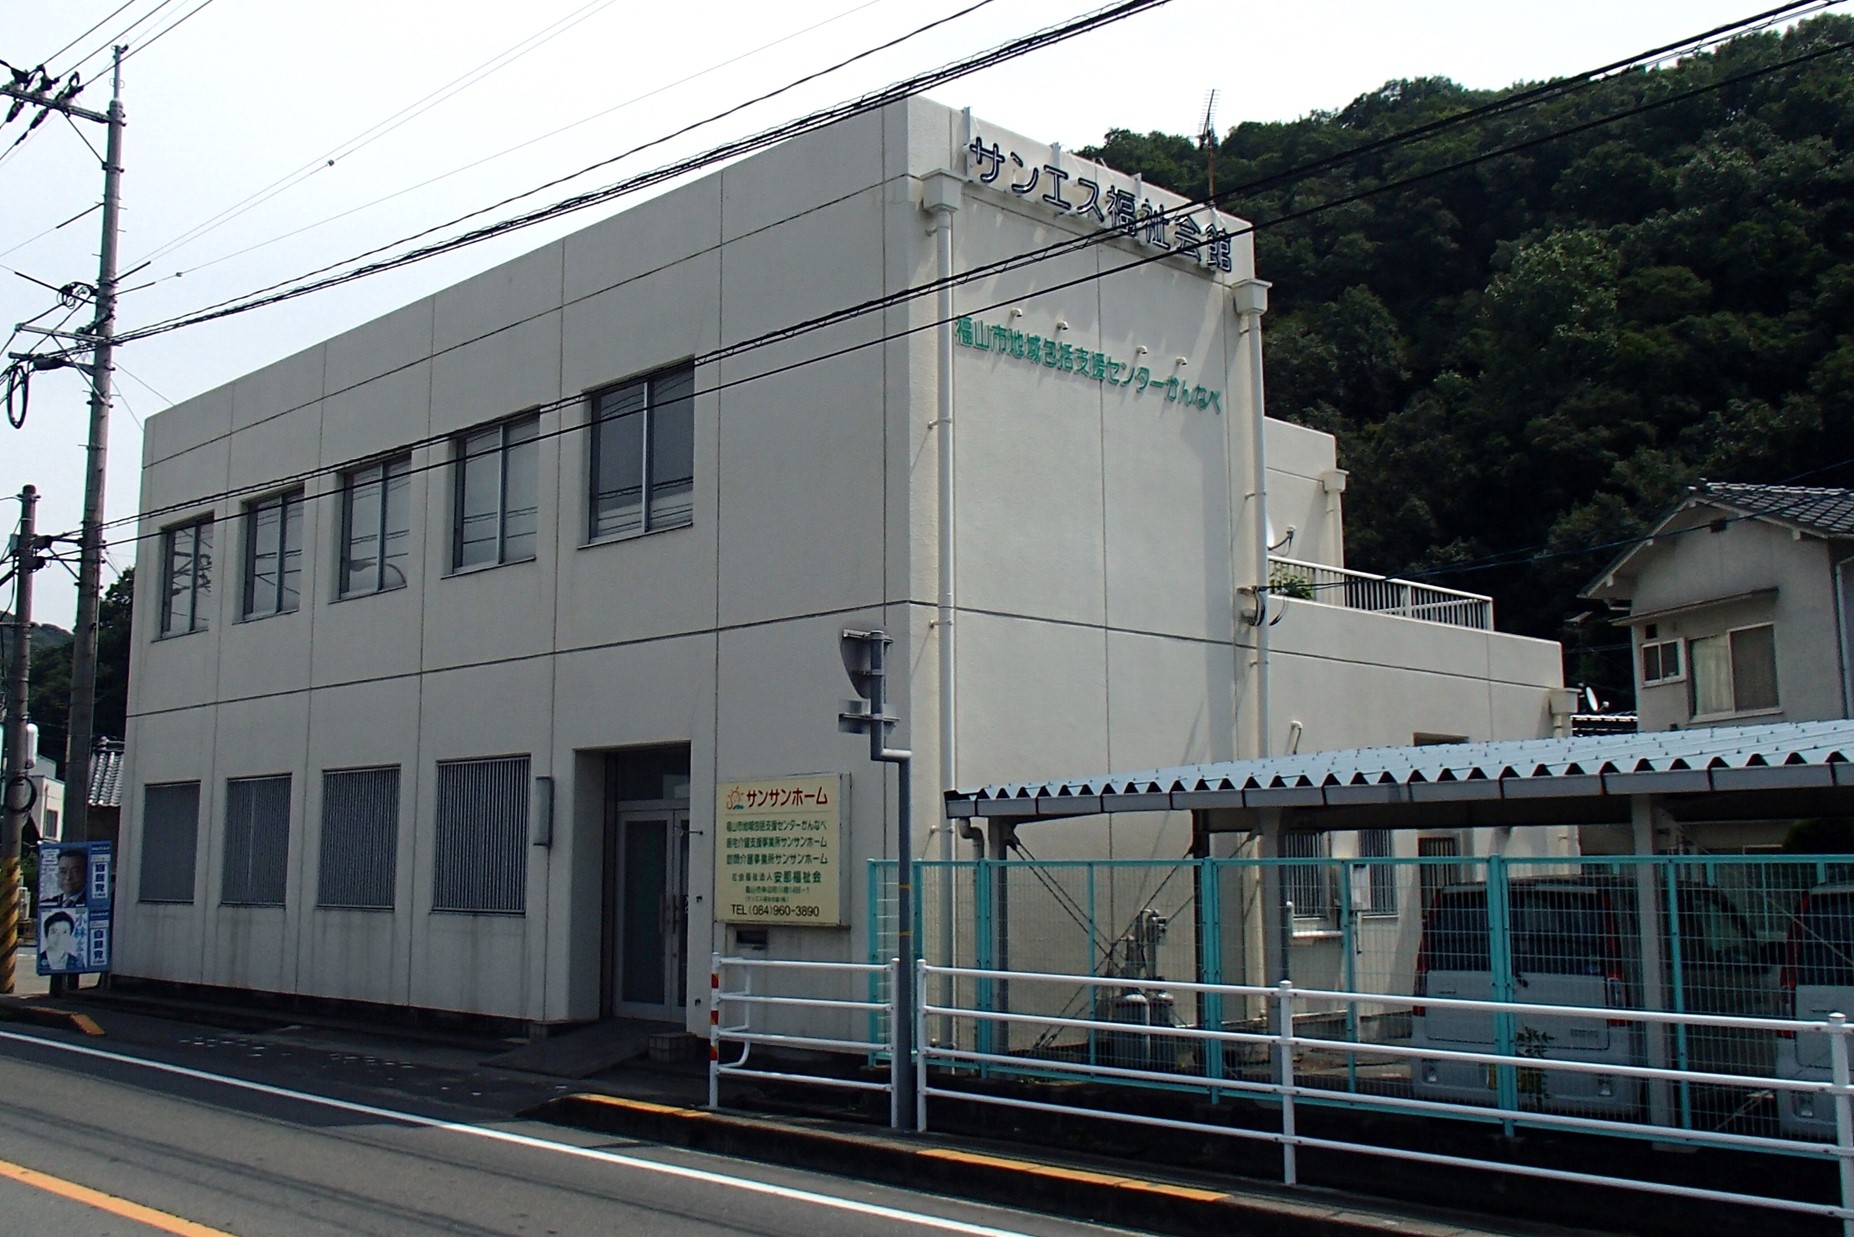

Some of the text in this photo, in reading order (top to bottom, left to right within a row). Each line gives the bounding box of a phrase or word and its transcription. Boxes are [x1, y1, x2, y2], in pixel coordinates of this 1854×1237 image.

[968, 136, 1232, 273] サンエス福祉会館
[746, 786, 828, 807] サンサンホーム
